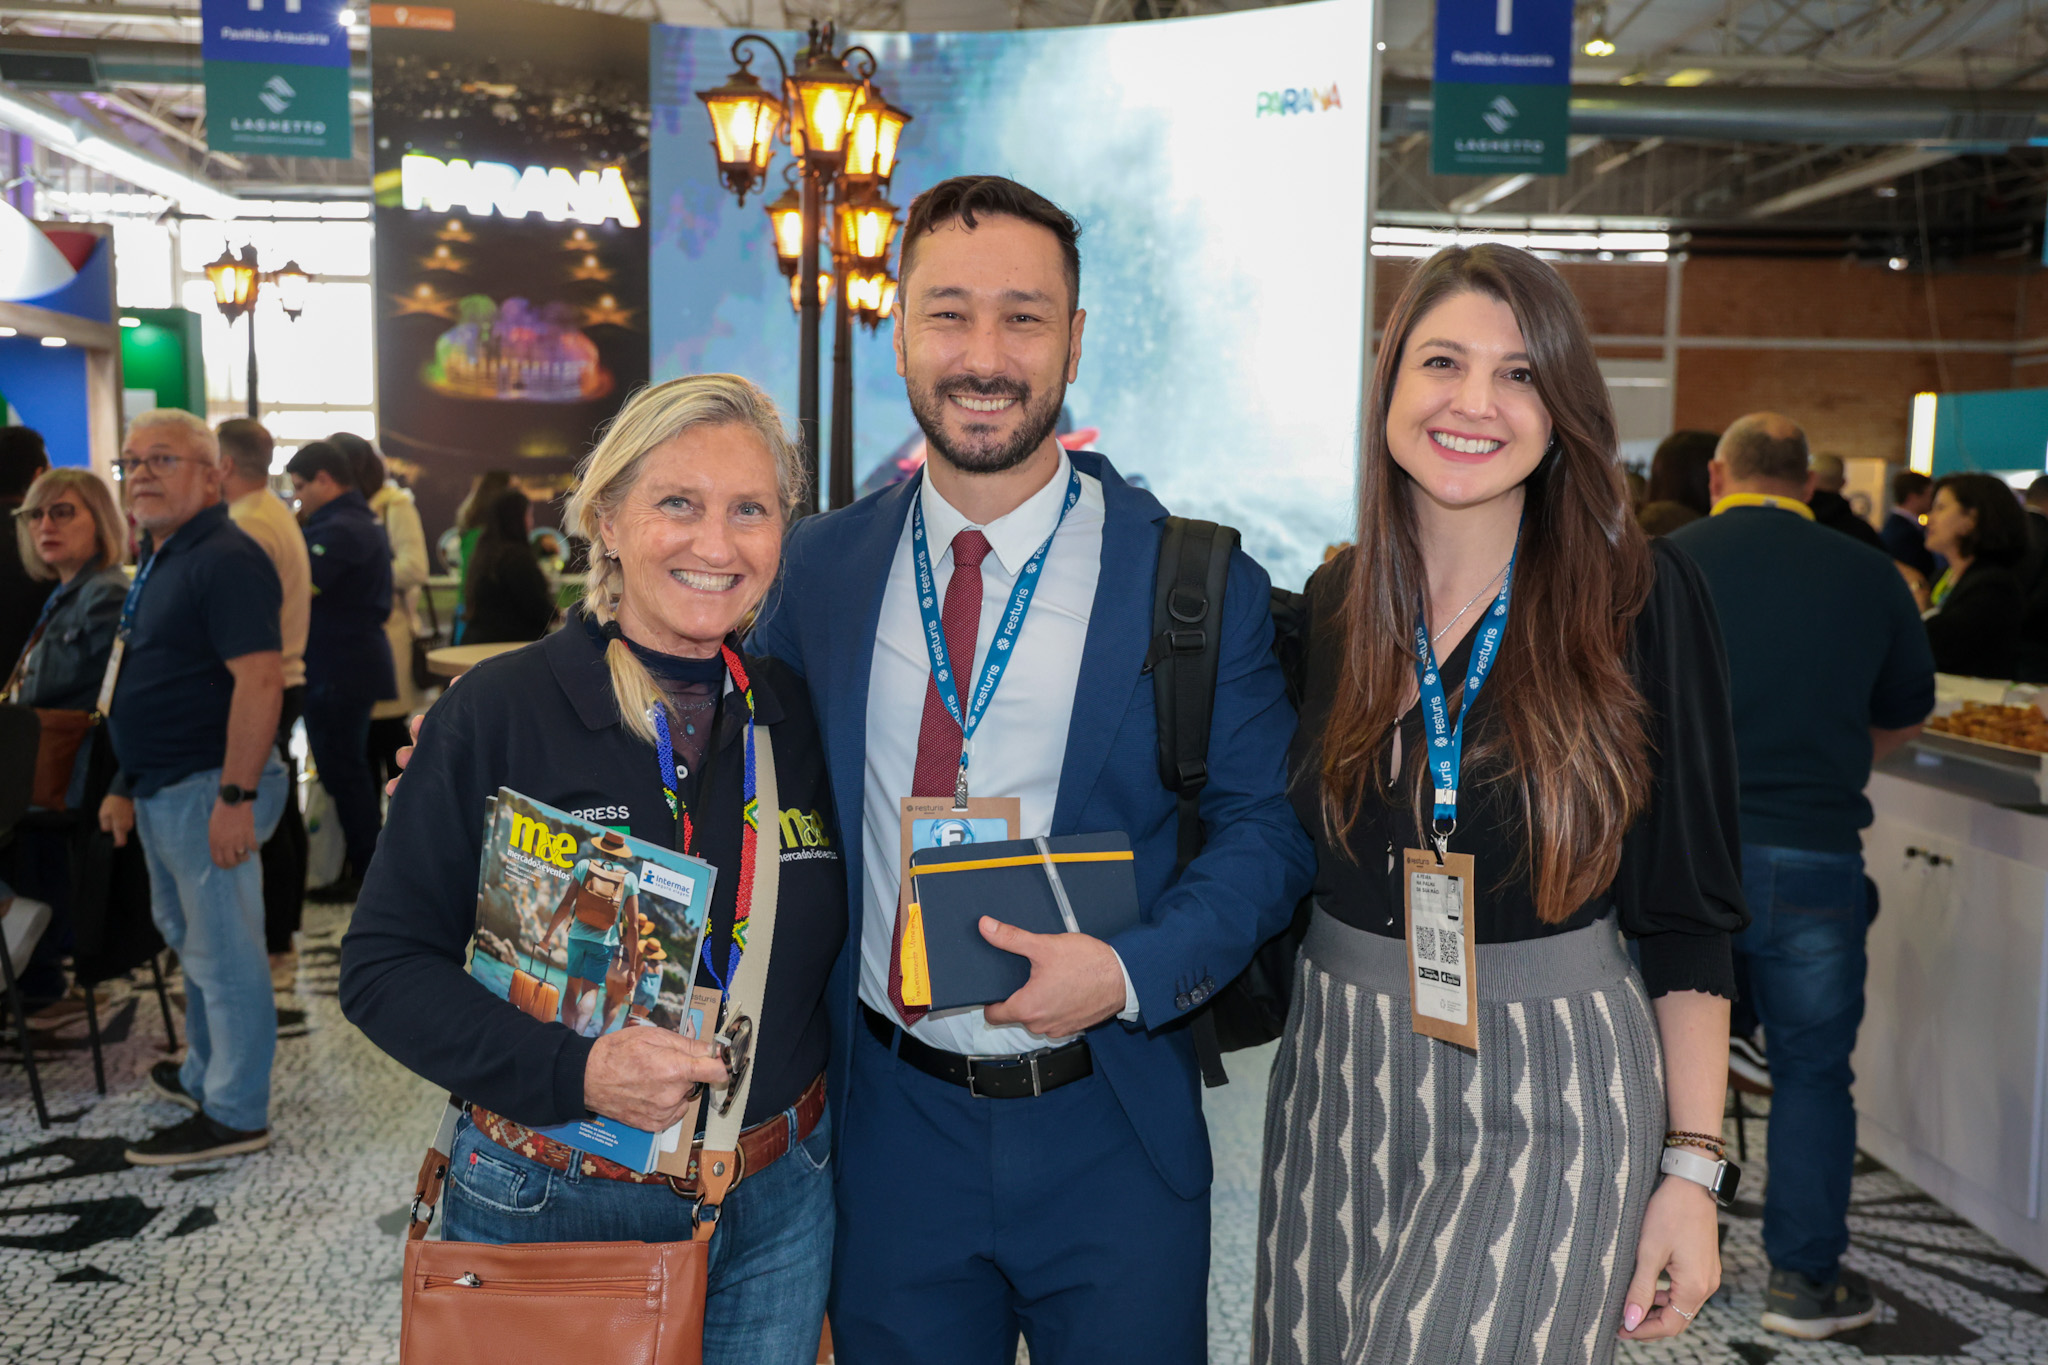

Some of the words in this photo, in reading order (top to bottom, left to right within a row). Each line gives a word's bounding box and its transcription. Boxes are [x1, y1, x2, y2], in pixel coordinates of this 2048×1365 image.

[230, 117, 326, 135] LAGHETTO
[1454, 138, 1545, 154] LAGHETTO
[917, 550, 931, 594] Festuris
[1004, 588, 1030, 636] Festuris
[928, 620, 945, 667] Festuris
[1477, 628, 1498, 676] Festuris
[975, 664, 1000, 713] Festuris
[1429, 696, 1446, 735] Festuris
[571, 805, 630, 821] PRESS
[509, 811, 578, 869] m&e
[507, 849, 571, 881] mercado&eventos
